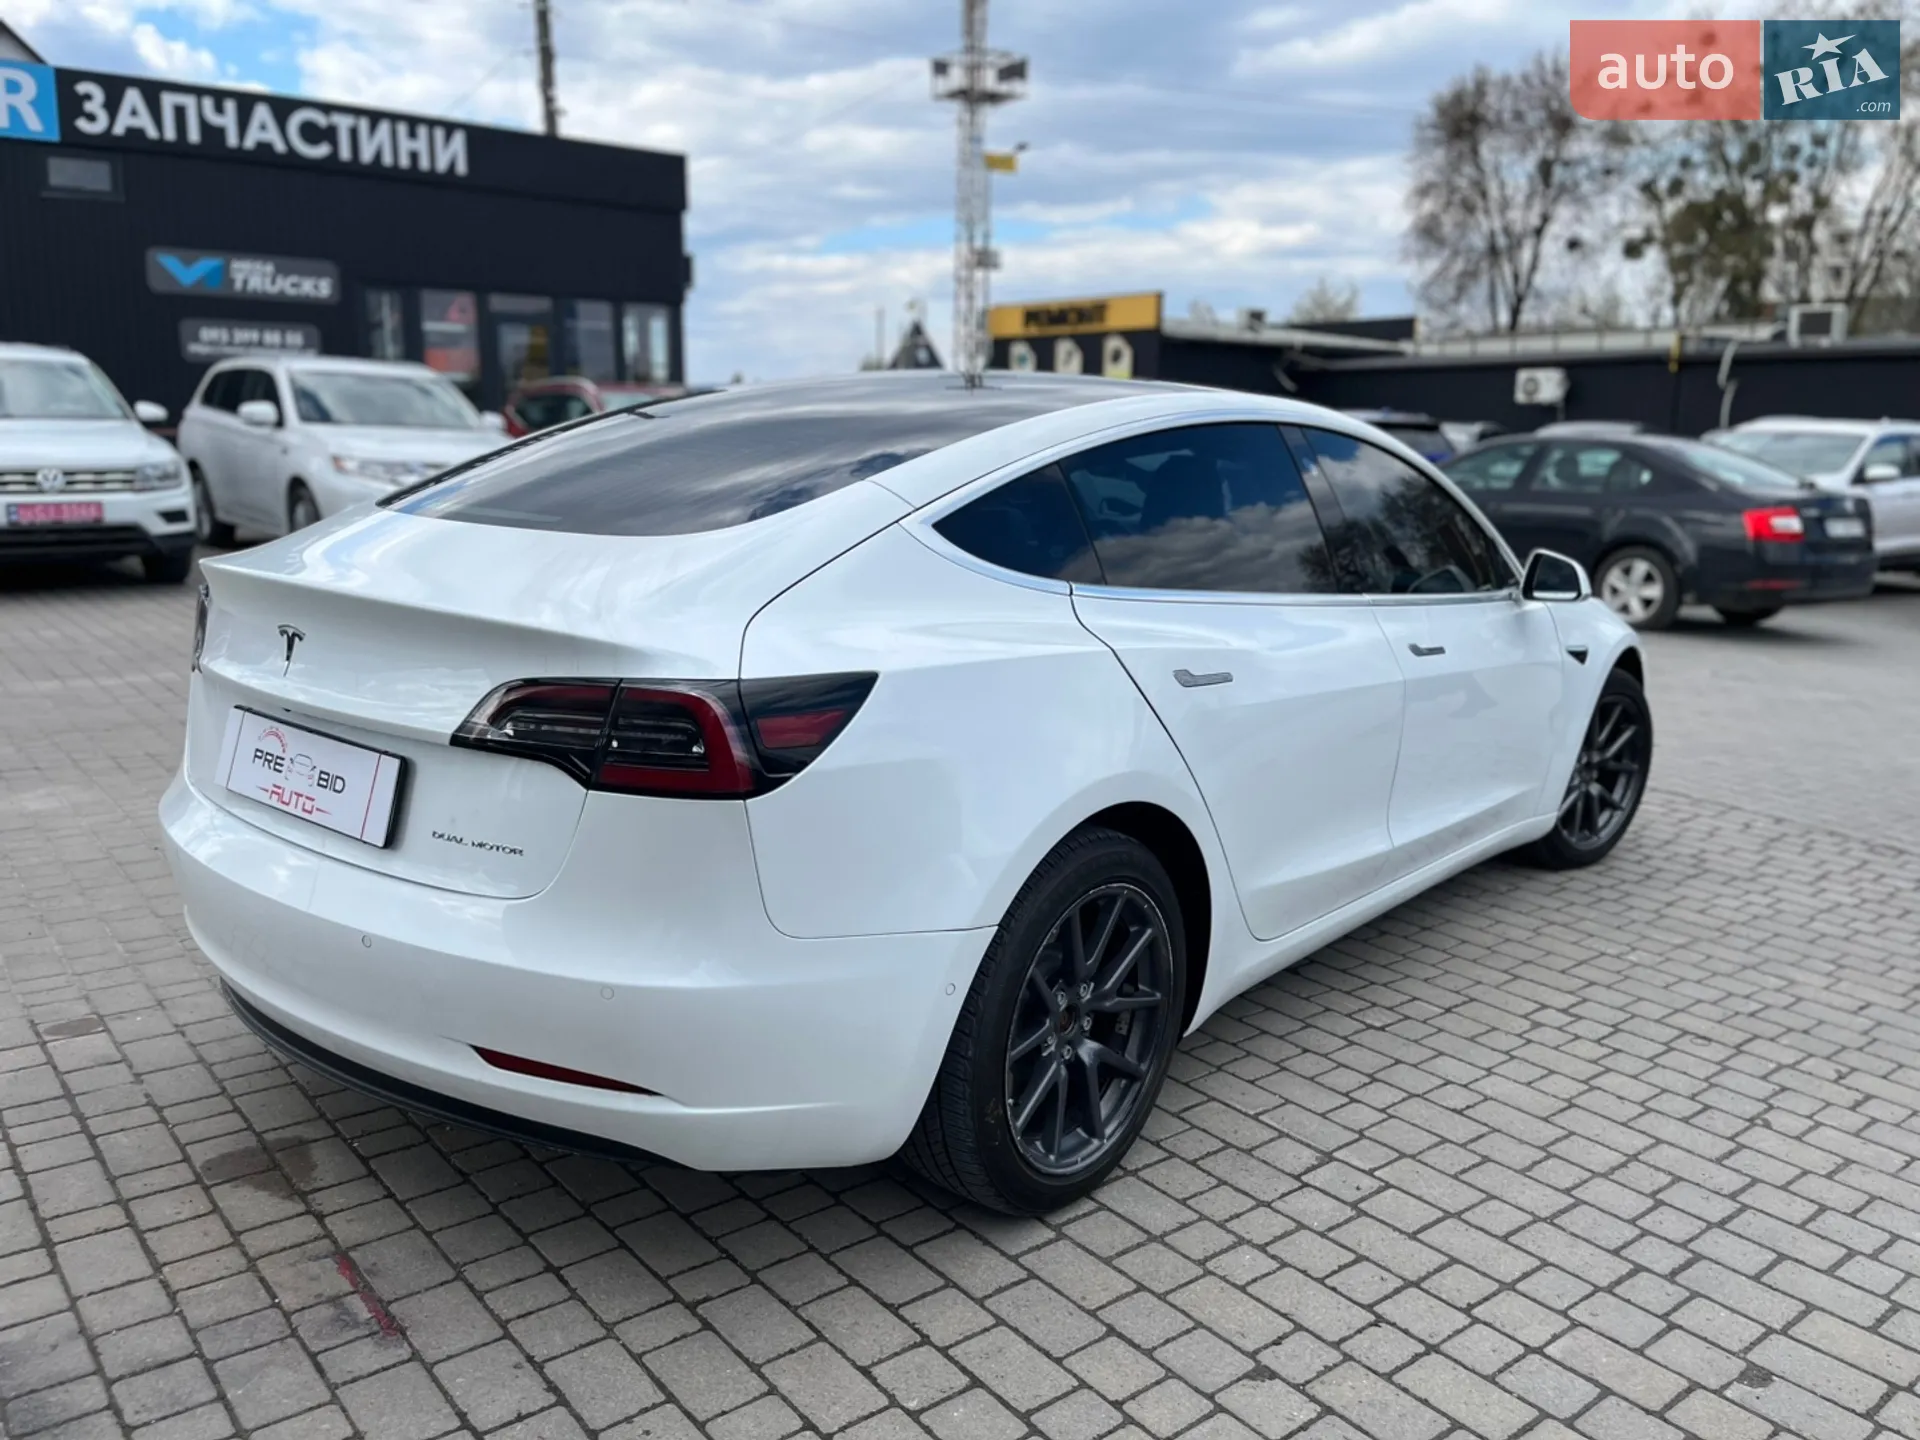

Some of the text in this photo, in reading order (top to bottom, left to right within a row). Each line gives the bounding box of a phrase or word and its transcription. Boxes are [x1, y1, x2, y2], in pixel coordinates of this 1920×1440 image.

[73, 80, 469, 177] ЗАПЧАСТИНИ
[231, 270, 333, 299] TRUCKS
[251, 747, 346, 795] PRE BID
[269, 783, 316, 815] AUTO
[431, 830, 524, 856] DUAL MOTOR
